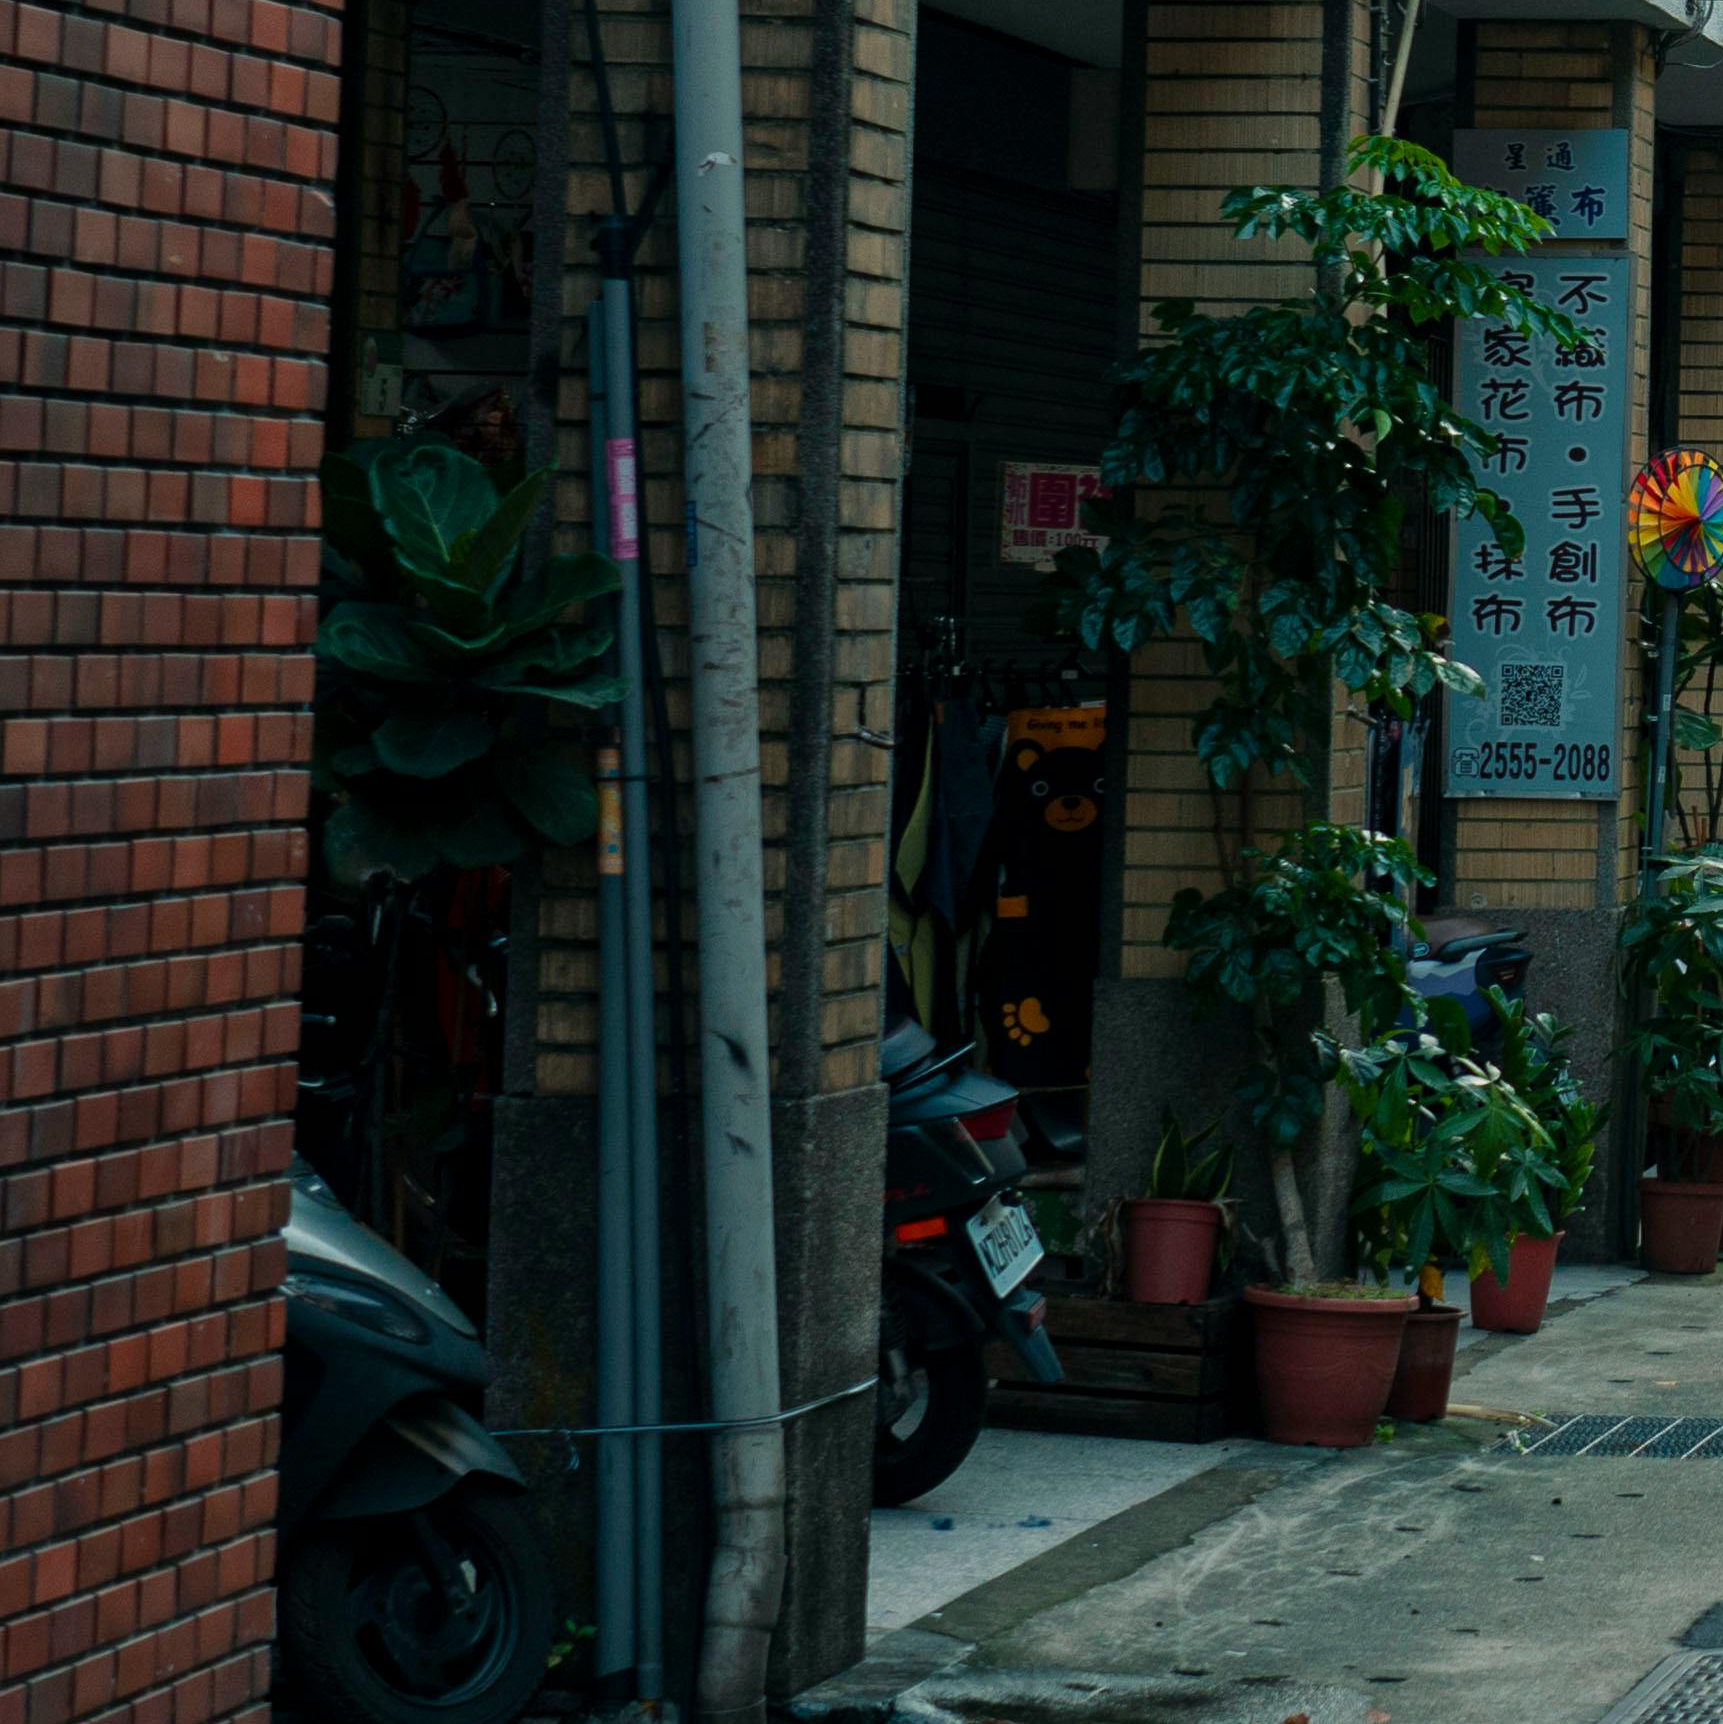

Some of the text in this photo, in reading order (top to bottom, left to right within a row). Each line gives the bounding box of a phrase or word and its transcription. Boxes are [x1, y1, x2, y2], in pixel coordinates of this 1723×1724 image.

[1504, 142, 1577, 172] 星通
[1484, 184, 1606, 227] 簾布
[1480, 740, 1610, 782] 2555-2088
